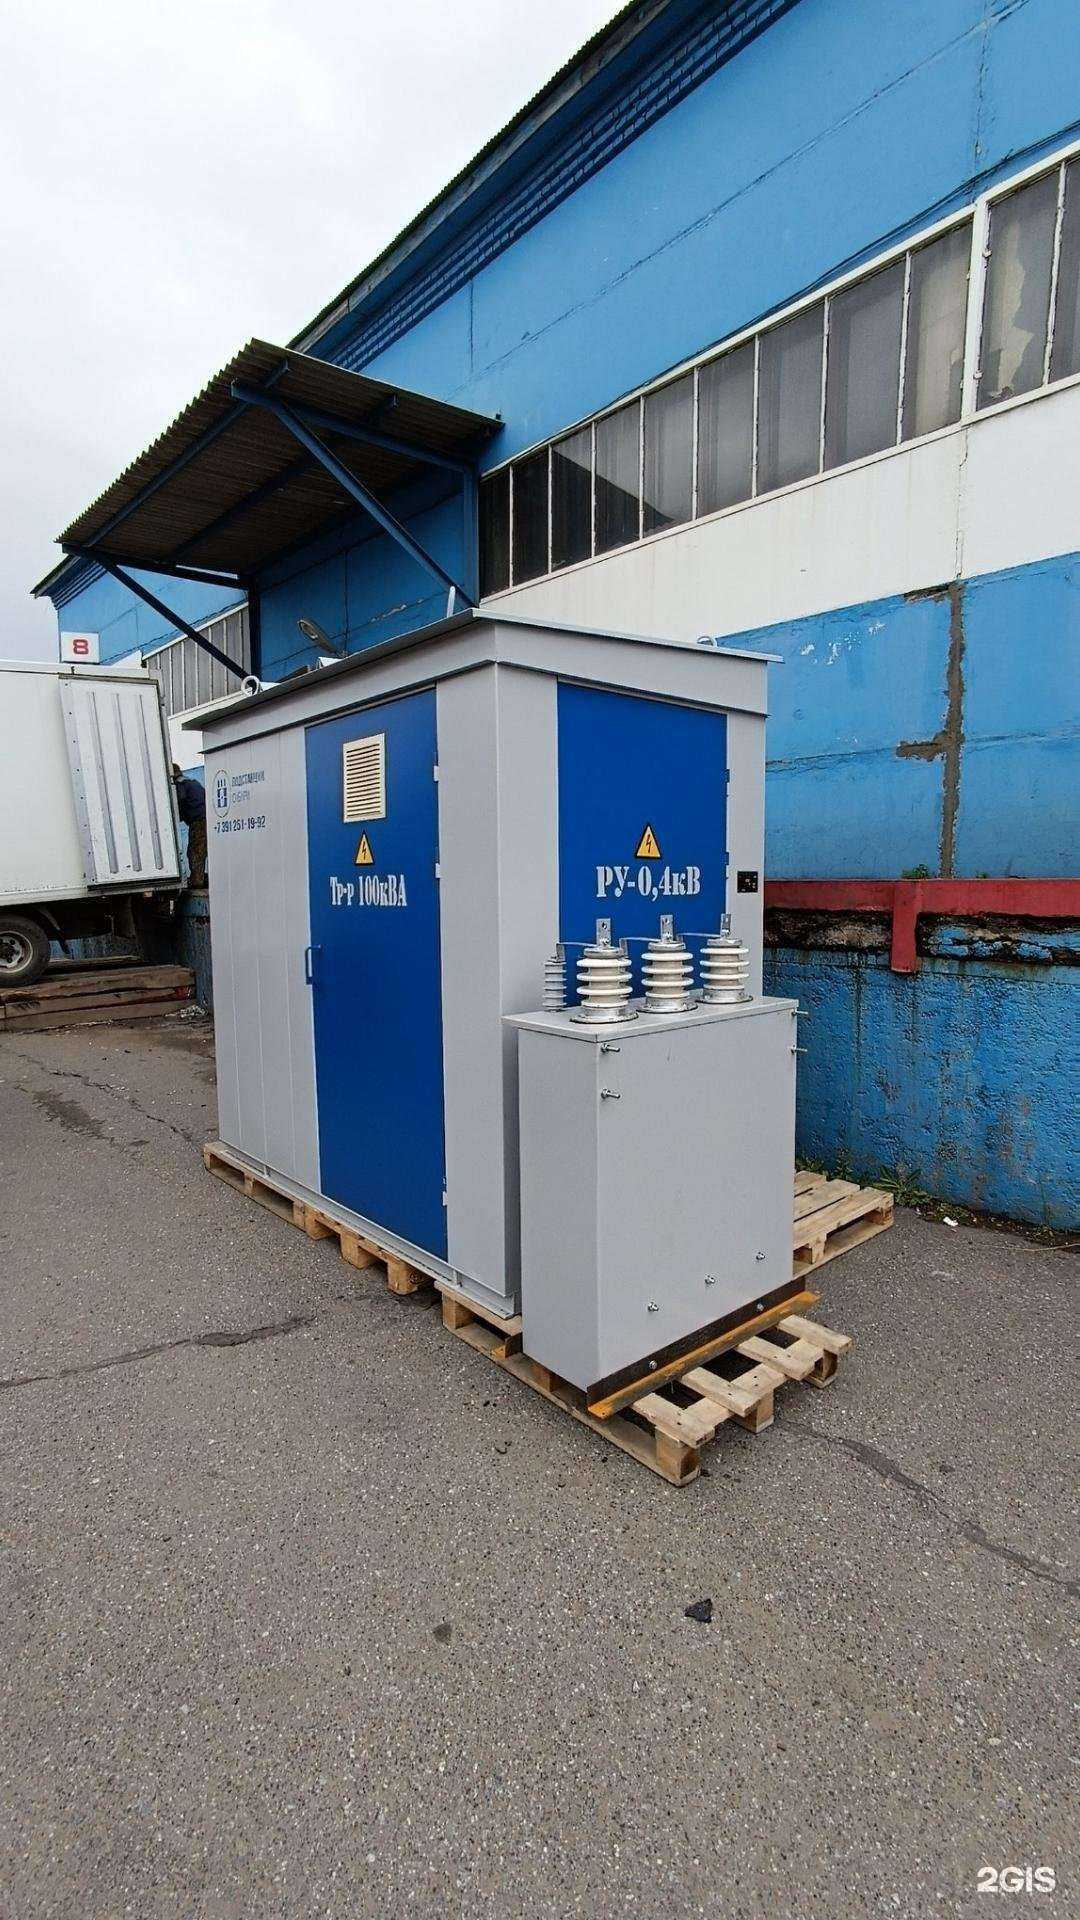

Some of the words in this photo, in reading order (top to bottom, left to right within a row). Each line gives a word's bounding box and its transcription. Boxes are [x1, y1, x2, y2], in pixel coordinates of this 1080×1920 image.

[73, 639, 89, 655] 8
[329, 876, 354, 906] Тр-р
[358, 873, 407, 907] 100кВА
[596, 866, 701, 901] РУ-0,4кВ
